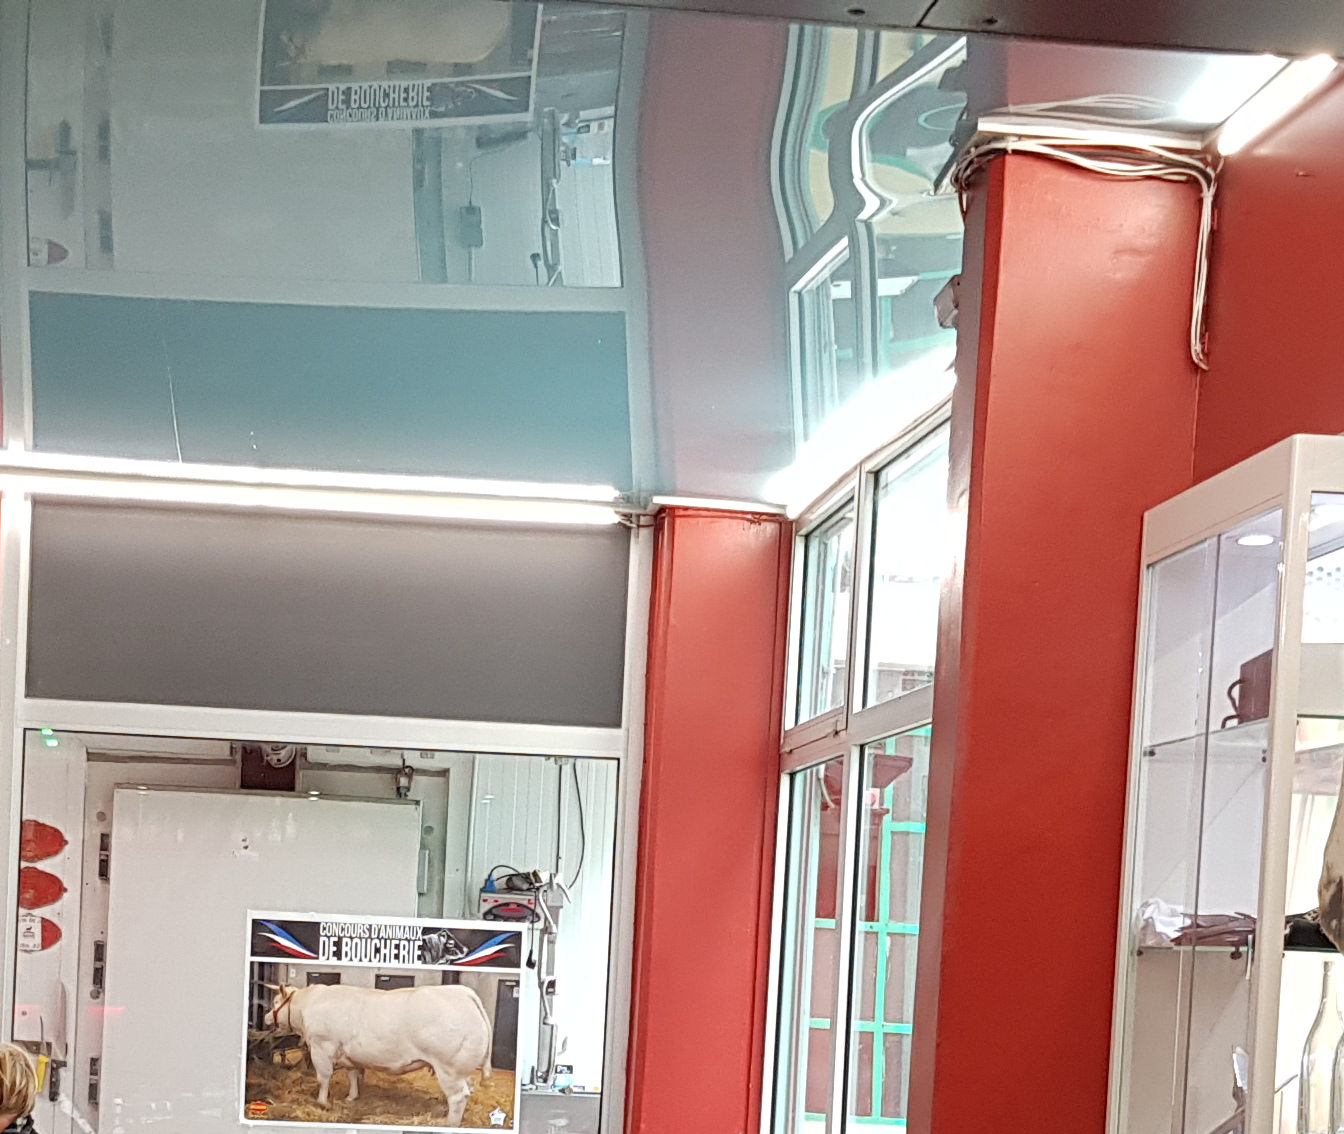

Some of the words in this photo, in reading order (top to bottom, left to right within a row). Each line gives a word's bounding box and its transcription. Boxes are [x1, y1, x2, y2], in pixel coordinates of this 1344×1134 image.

[319, 922, 369, 938] CONCOURS
[371, 925, 424, 940] D'ANIMAUX
[319, 937, 338, 962] DE
[341, 937, 423, 965] BOUCHERIE
